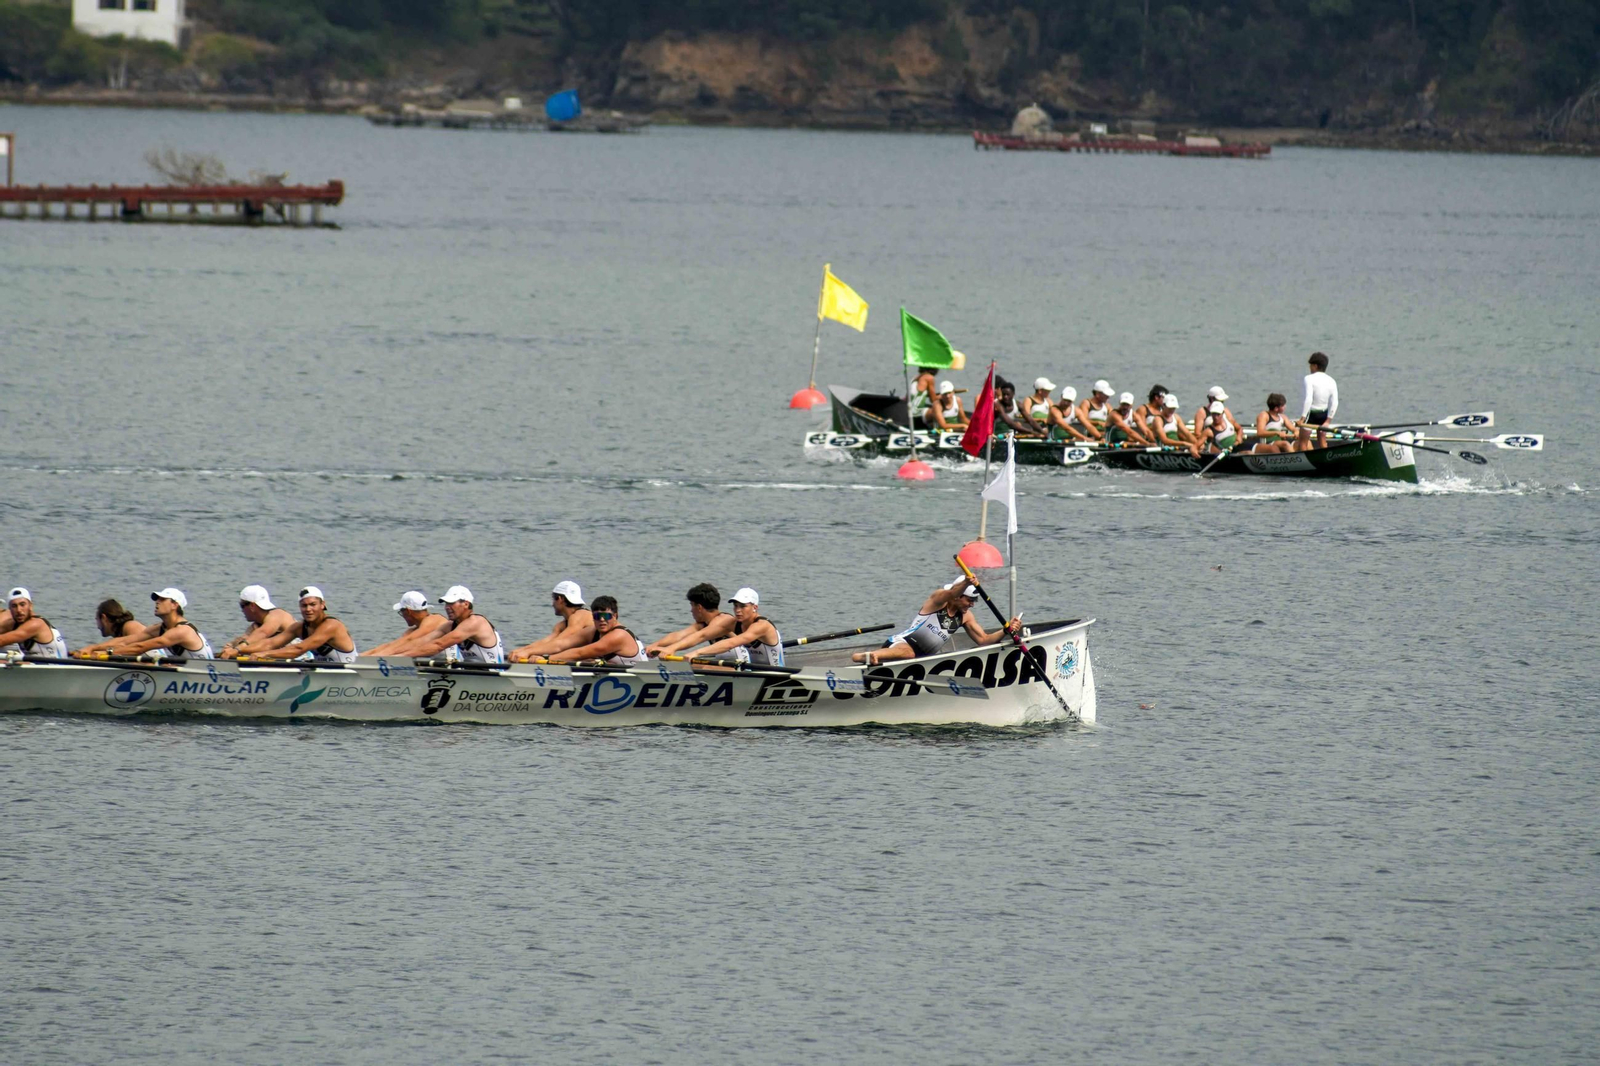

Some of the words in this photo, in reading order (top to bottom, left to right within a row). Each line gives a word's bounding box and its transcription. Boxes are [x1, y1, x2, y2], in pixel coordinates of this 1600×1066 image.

[1135, 453, 1202, 470] CAMPOS
[115, 673, 152, 685] BMW
[326, 686, 412, 698] BIOMEGA
[457, 690, 536, 704] Deputación
[159, 696, 266, 706] CONCESIONARIO
[452, 702, 472, 713] DA
[475, 701, 530, 713] CORUÑA
[748, 703, 813, 711] Construcciones
